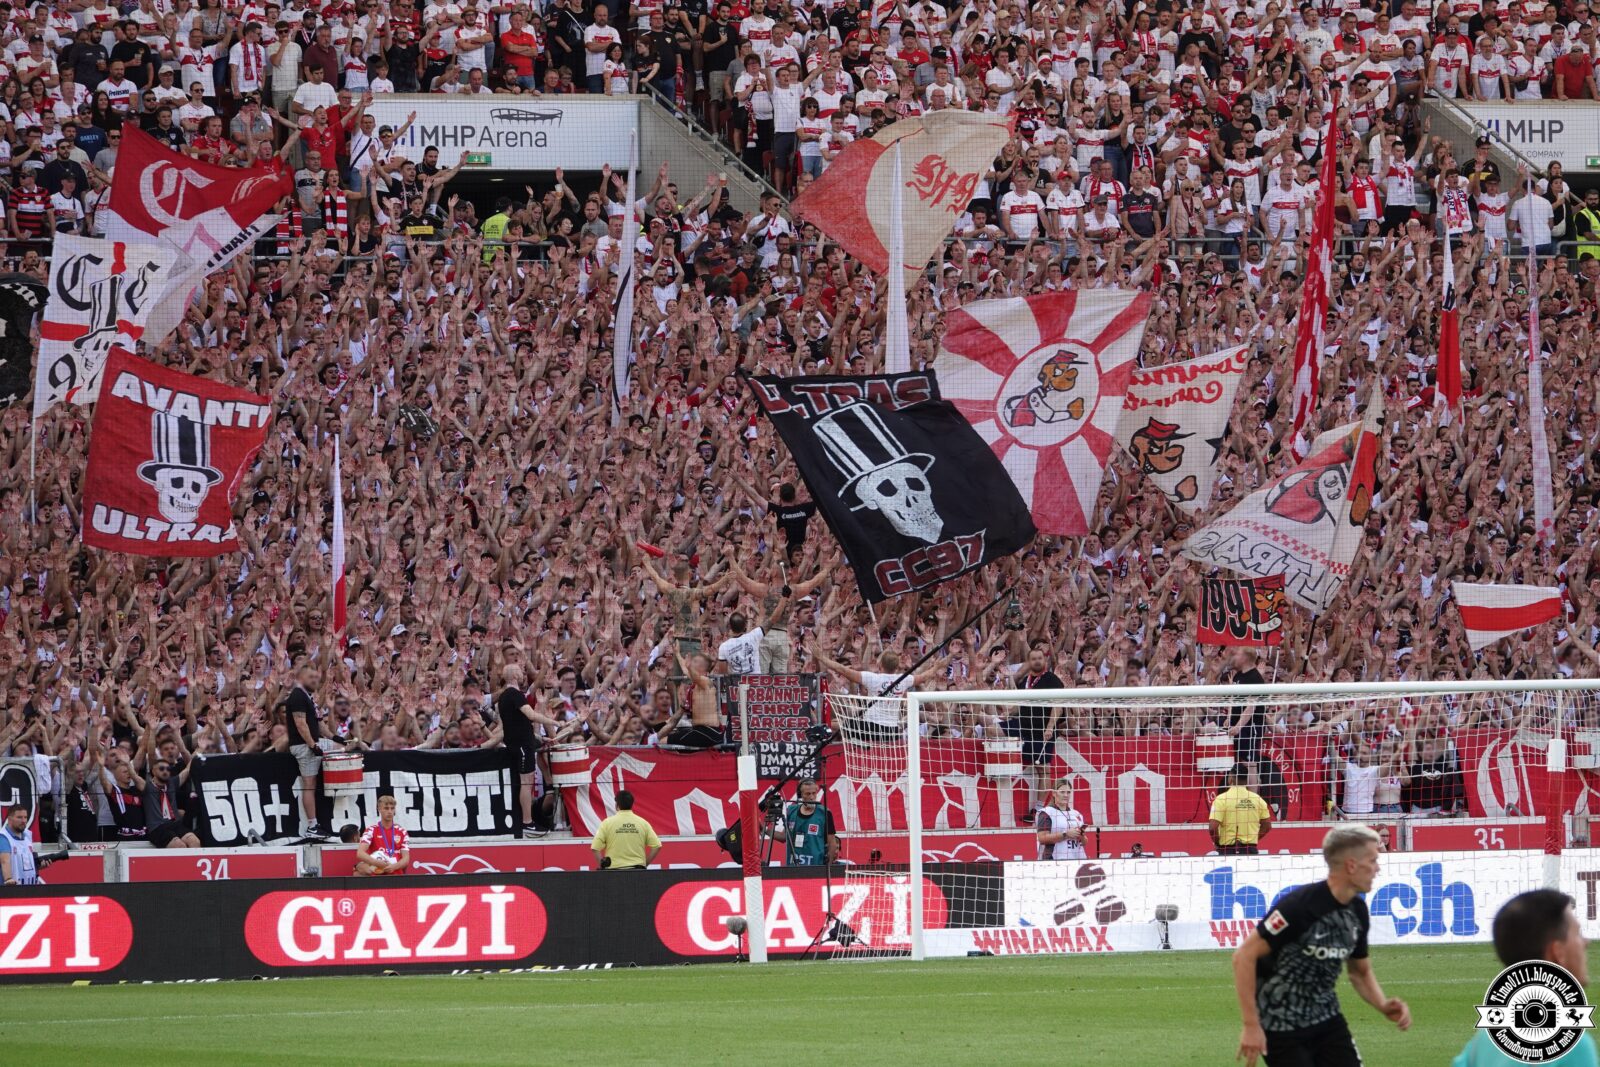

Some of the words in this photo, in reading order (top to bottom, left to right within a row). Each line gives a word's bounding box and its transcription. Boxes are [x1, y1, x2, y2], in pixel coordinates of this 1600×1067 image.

[421, 125, 476, 147] MHP
[478, 125, 548, 147] Arena
[1506, 119, 1564, 143] MHP
[111, 371, 272, 429] AVANTI
[749, 376, 931, 419] UTRAS
[92, 503, 238, 543] ULTRAS
[873, 528, 987, 597] CC97
[1200, 578, 1263, 641] 1997
[738, 675, 800, 686] JEDER
[728, 686, 810, 702] VRBANNTE
[760, 742, 779, 753] DU
[785, 743, 817, 755] BIST
[761, 766, 780, 776] BEI
[1287, 788, 1300, 804] 97
[1474, 827, 1505, 850] 35
[197, 858, 230, 881] 34
[972, 926, 1114, 956] WINAMAX
